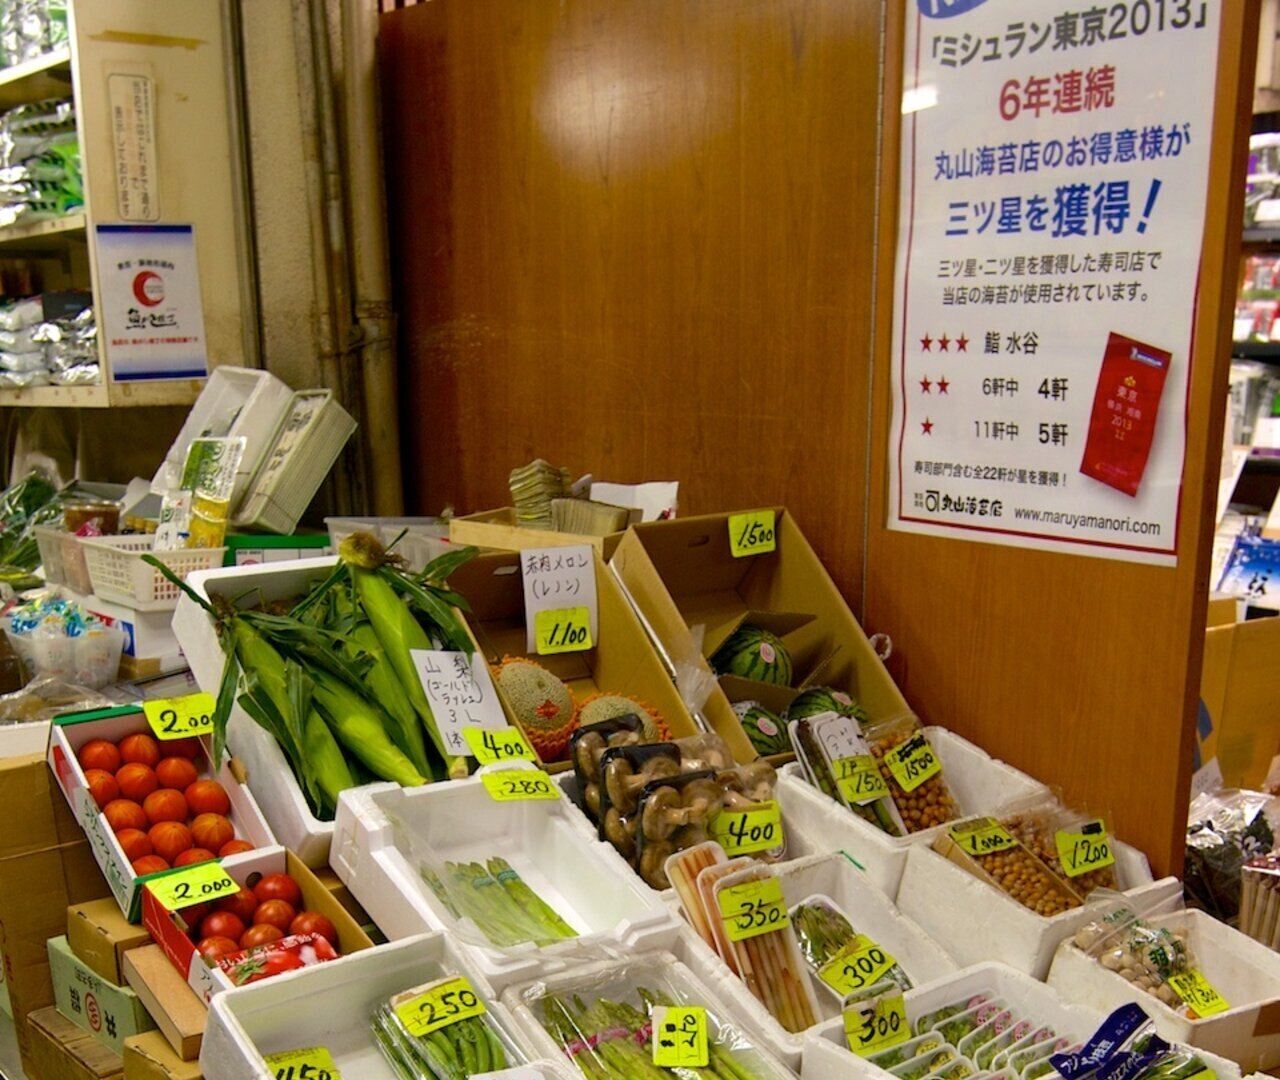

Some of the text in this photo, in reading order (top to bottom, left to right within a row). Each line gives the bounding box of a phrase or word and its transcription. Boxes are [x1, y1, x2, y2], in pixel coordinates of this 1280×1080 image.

[999, 64, 1116, 121] 6年連続
[934, 122, 1191, 181] 丸山海苔店のお得意様が
[942, 281, 1149, 306] 当店の海苔が使用されています。
[1006, 331, 1039, 355] 水谷
[982, 377, 1068, 402] 6軒中 4軒
[974, 420, 1068, 447] 11軒中 5軒
[1013, 506, 1162, 536] www.maruyamanori.com
[502, 780, 550, 795] 280
[728, 815, 775, 844] 400
[843, 947, 887, 989] 300
[418, 988, 478, 1024] 250
[858, 1008, 901, 1045] 300
